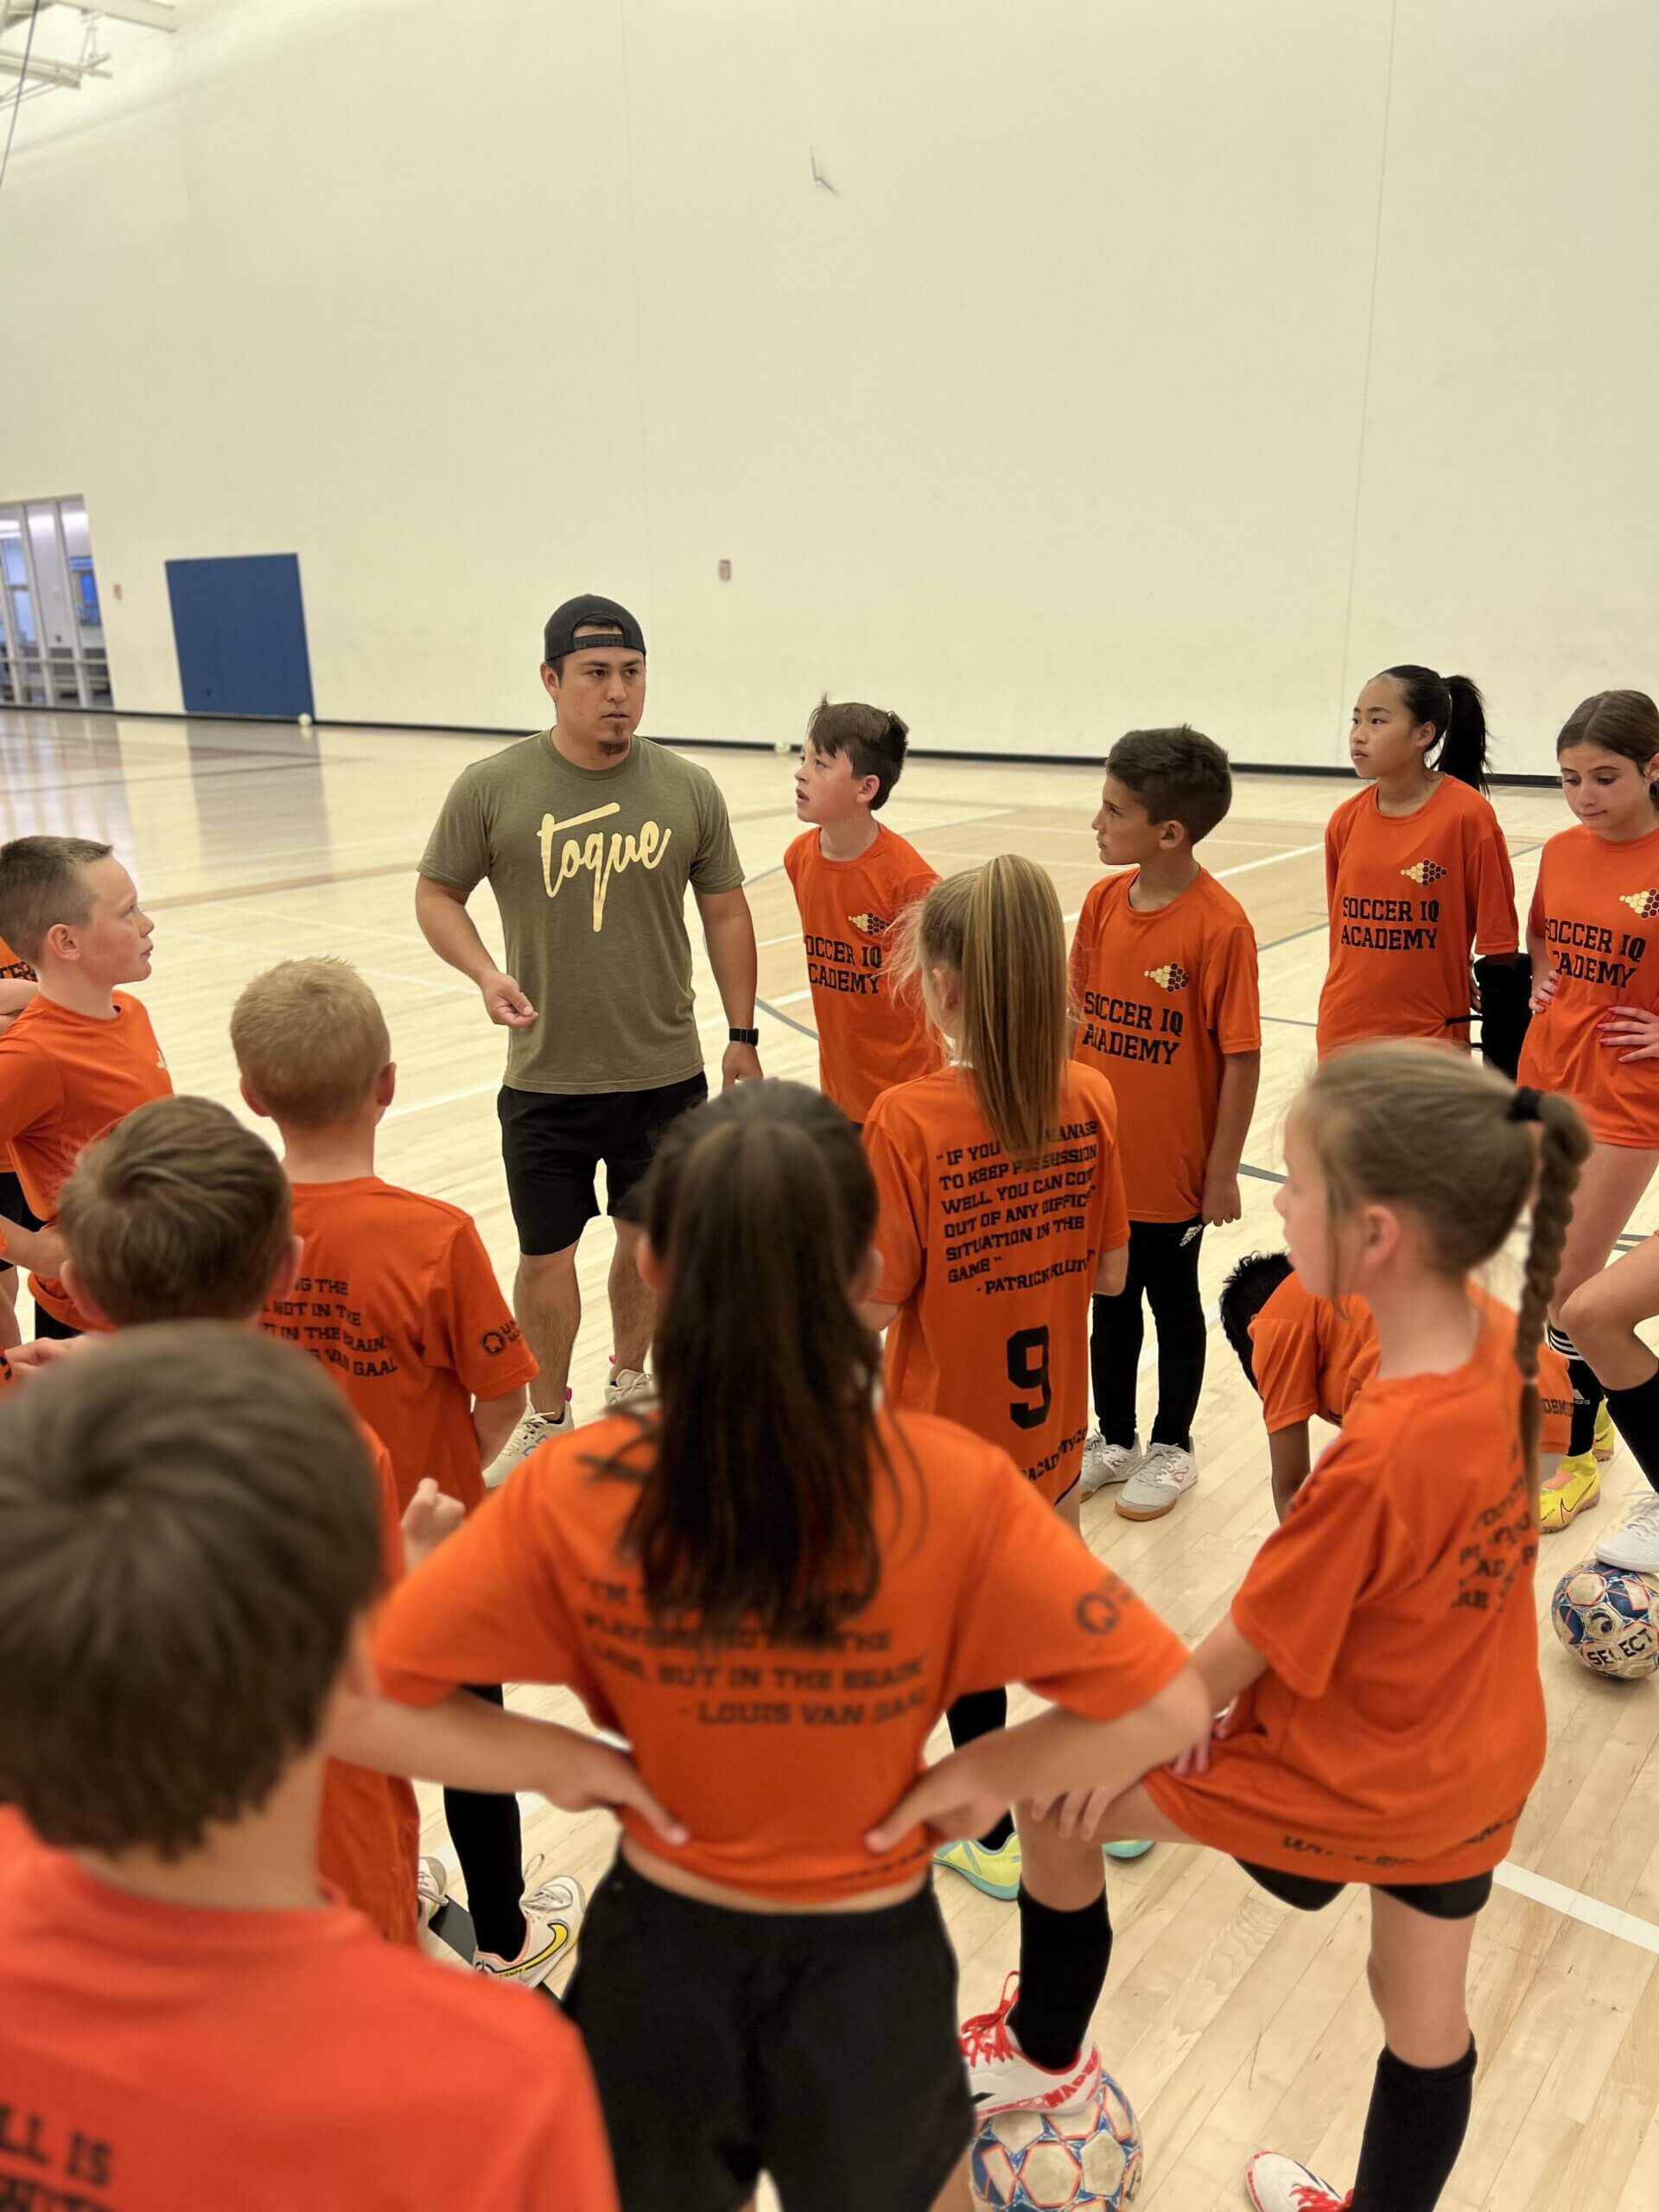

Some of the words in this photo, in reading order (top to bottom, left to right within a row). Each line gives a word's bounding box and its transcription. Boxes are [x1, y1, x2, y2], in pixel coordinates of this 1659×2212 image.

[1343, 896, 1413, 922] SOCCER
[1420, 899, 1440, 923] IQ
[1341, 925, 1438, 950] ACADEMY
[1545, 918, 1612, 954] OCCER
[1619, 933, 1646, 963] IQ
[804, 935, 856, 966] OCCER
[861, 945, 883, 969] IQ
[808, 963, 880, 995] CADEMY
[1553, 950, 1638, 988] ADEMY
[1084, 991, 1153, 1031] SCCER
[1160, 1008, 1184, 1037] IQ
[1082, 1023, 1180, 1065] AADEMY
[968, 1141, 1001, 1161] YOU
[939, 1173, 964, 1191] TO
[969, 1163, 1009, 1186] KEEP
[996, 1182, 1029, 1201] YOU
[1033, 1174, 1062, 1194] CAN
[944, 1217, 977, 1238] OUT
[981, 1211, 1001, 1228] OF
[1006, 1204, 1039, 1224] ANY
[946, 1227, 1033, 1262] SITUATION
[1037, 1222, 1051, 1239] IN
[1052, 1216, 1085, 1233] THE
[948, 1257, 991, 1283] GAME
[985, 1268, 1051, 1294] PATRICK
[315, 1279, 348, 1296] THE
[335, 1304, 361, 1326] TE
[303, 1326, 340, 1340] THE
[353, 1357, 397, 1377] GAAL
[1007, 1325, 1052, 1429] 9
[773, 1665, 832, 1689] THE
